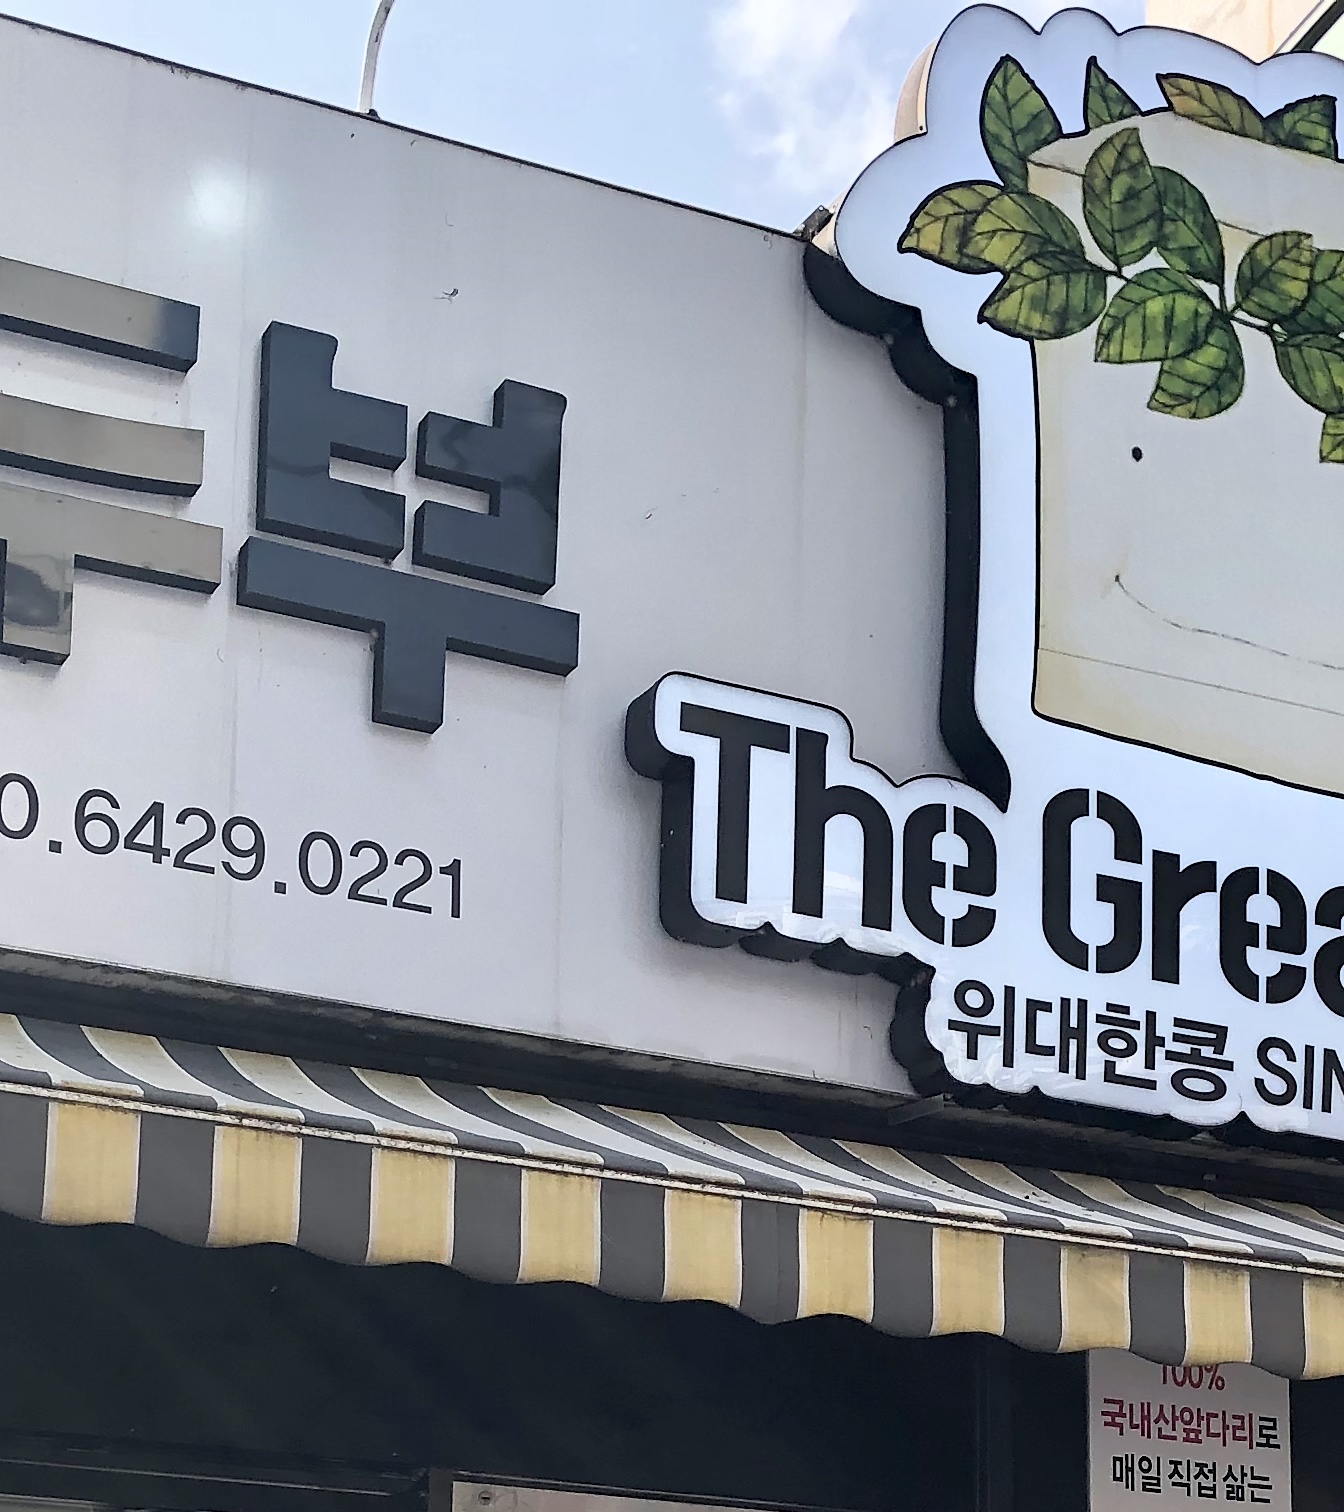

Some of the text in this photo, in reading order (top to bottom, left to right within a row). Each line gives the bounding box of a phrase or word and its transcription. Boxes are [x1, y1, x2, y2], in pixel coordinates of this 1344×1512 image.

[679, 703, 998, 948] The
[948, 978, 1234, 1102] 위대한콩
[1101, 1398, 1280, 1450] 국내산앞다리로
[1112, 1454, 1272, 1504] 매일 직접 삶는
